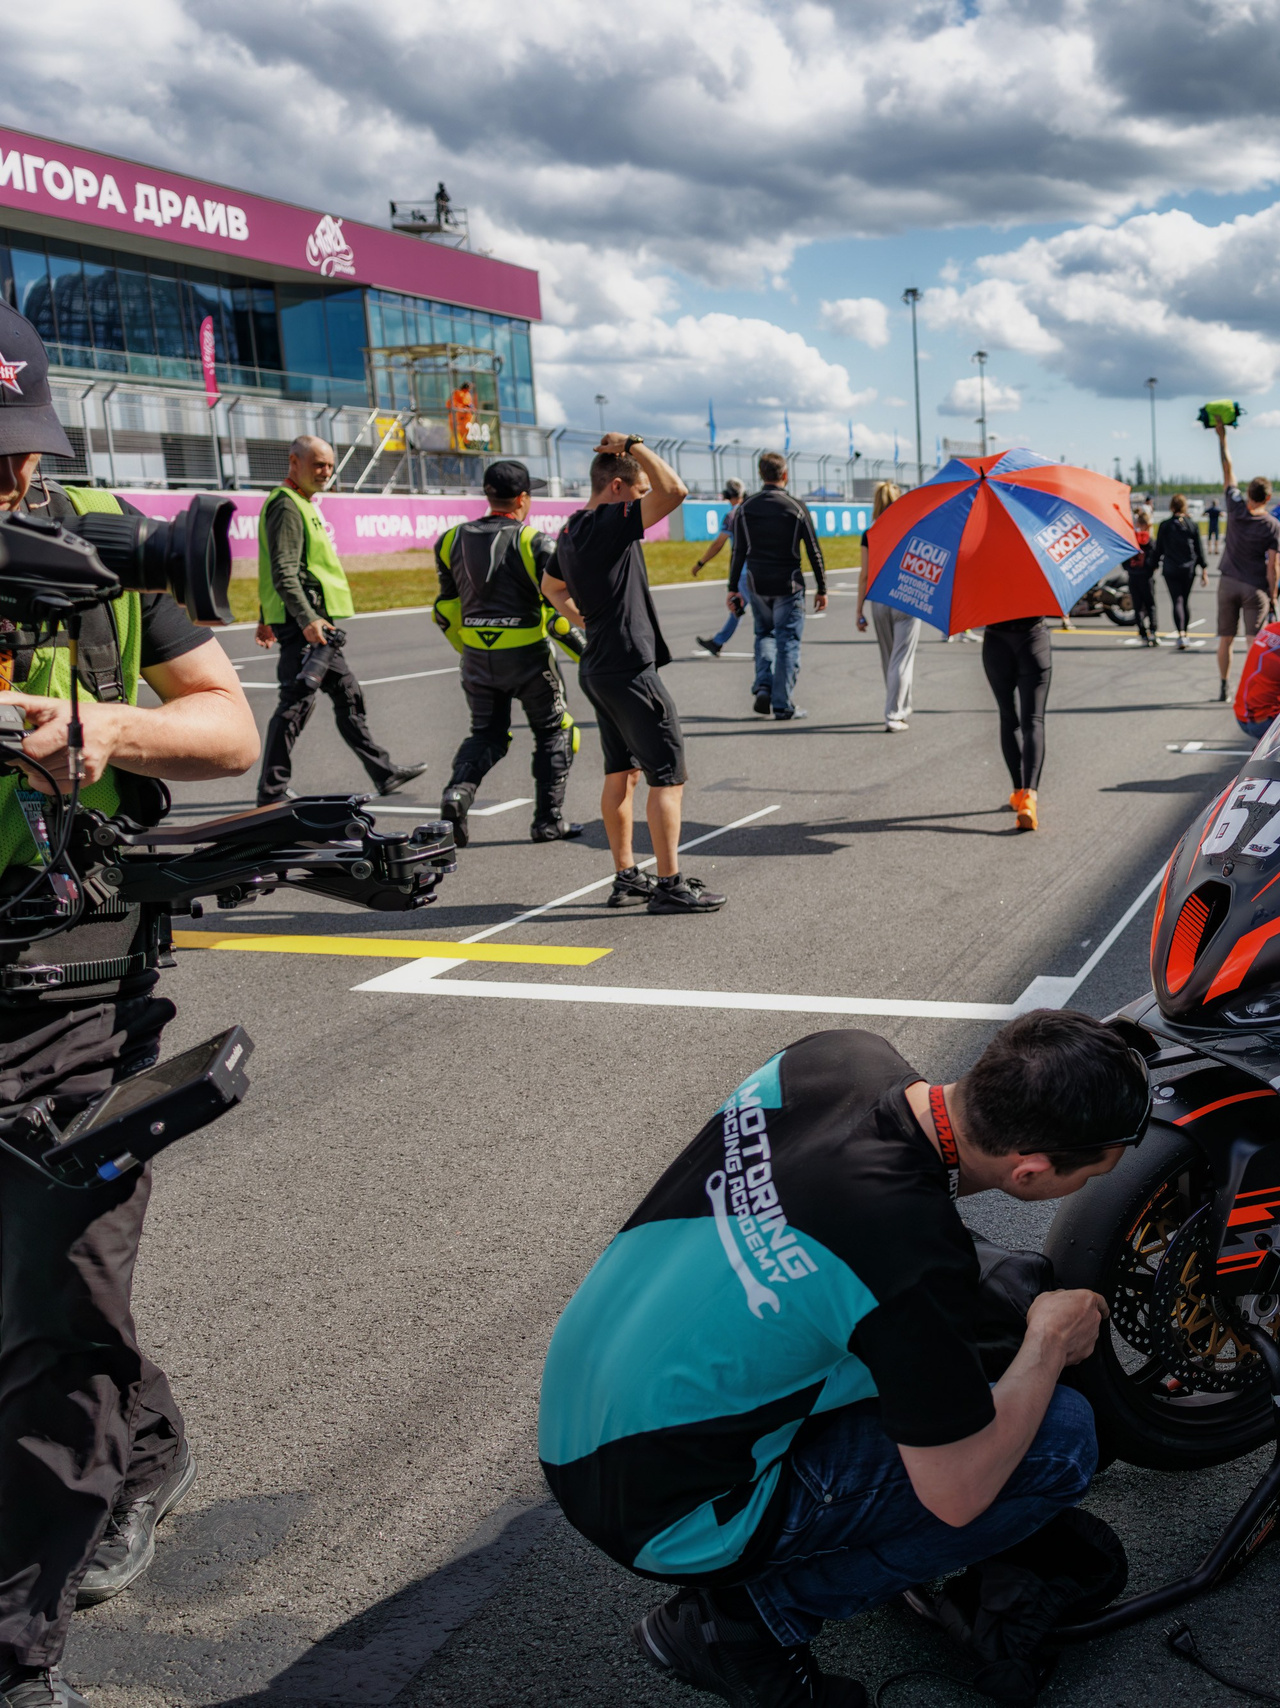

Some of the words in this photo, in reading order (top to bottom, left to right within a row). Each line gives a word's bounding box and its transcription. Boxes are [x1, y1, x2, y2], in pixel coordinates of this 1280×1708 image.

[0, 148, 128, 215] ИГОРА
[133, 182, 249, 242] ДРАЙВ
[355, 514, 414, 537] ИГОРА
[1034, 511, 1078, 550] LIQUI
[1047, 523, 1088, 563] MOLY
[902, 553, 944, 584] MOLY
[909, 538, 949, 568] LIQUI
[722, 1094, 743, 1173] RACING
[736, 1081, 819, 1280] MOTORING
[728, 1176, 789, 1283] ACADEMY
